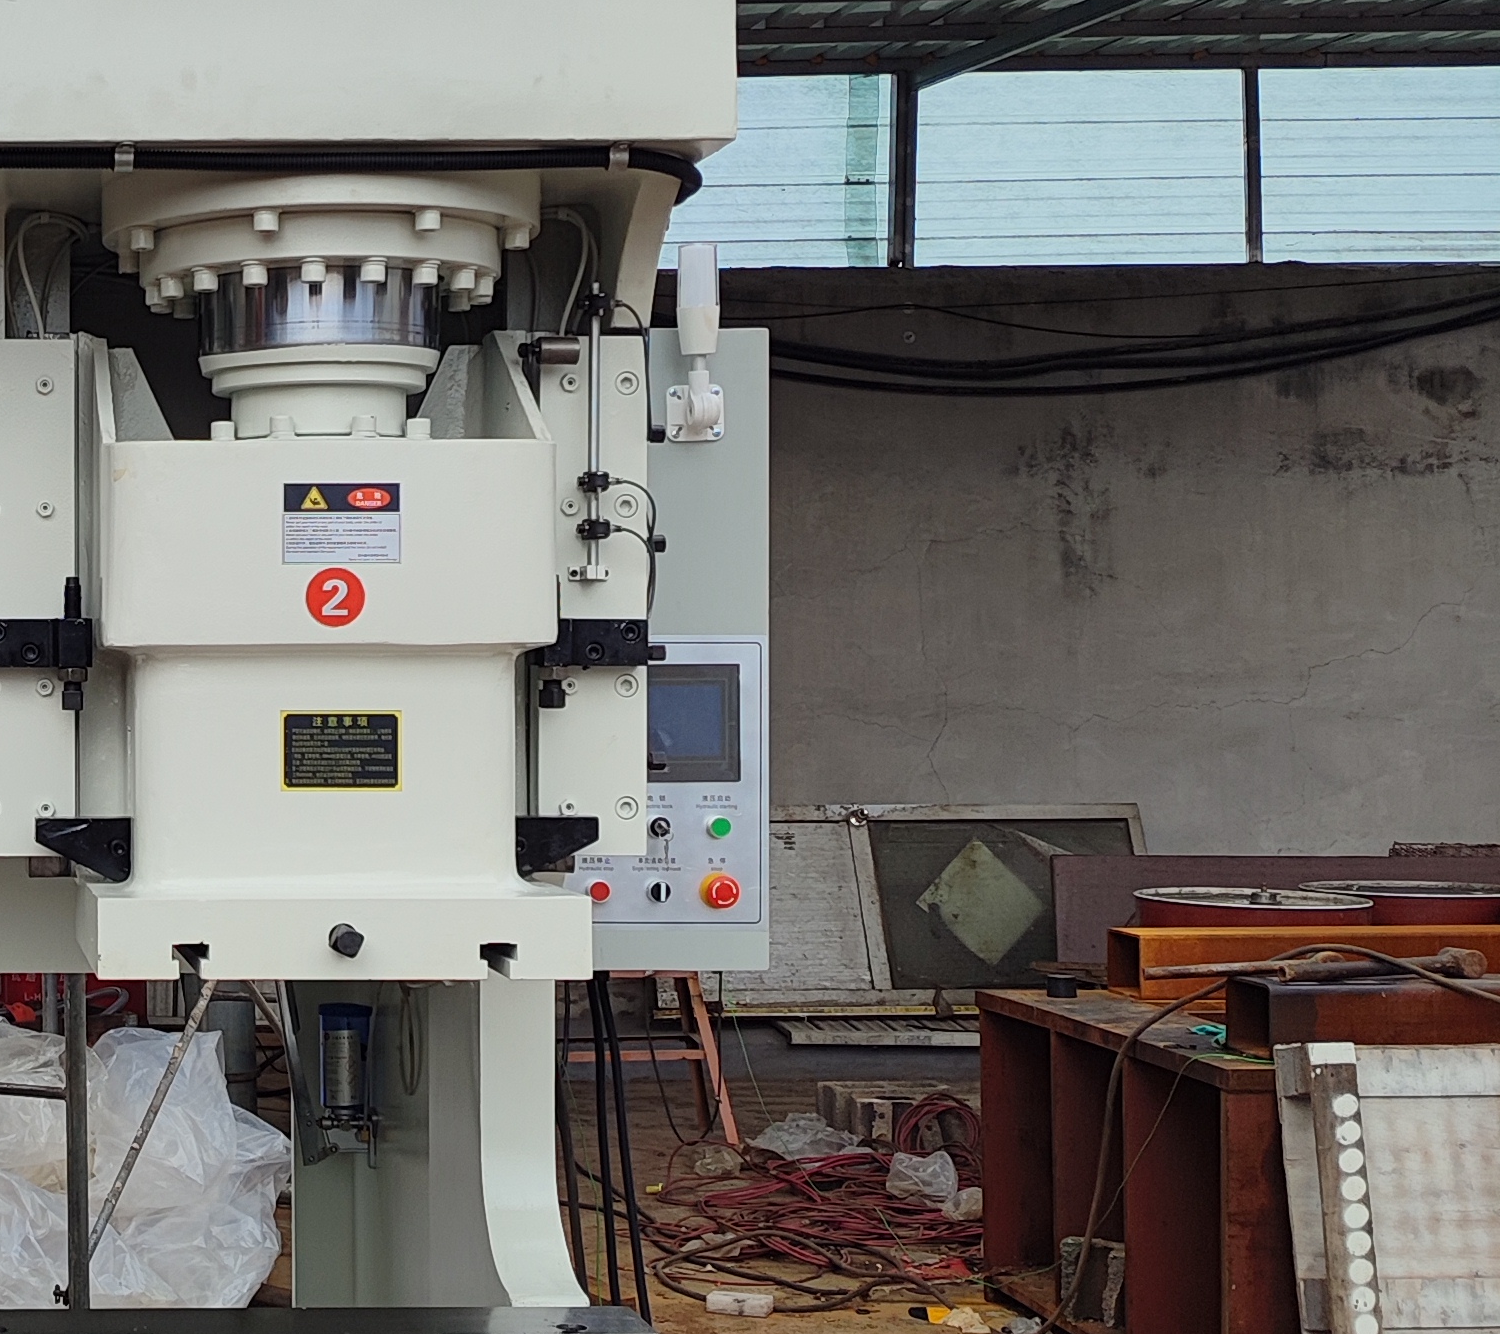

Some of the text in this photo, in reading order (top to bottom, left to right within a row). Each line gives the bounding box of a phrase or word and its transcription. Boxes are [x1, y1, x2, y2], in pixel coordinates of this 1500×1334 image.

[321, 579, 349, 616] 2
[312, 716, 369, 727] 注意事项
